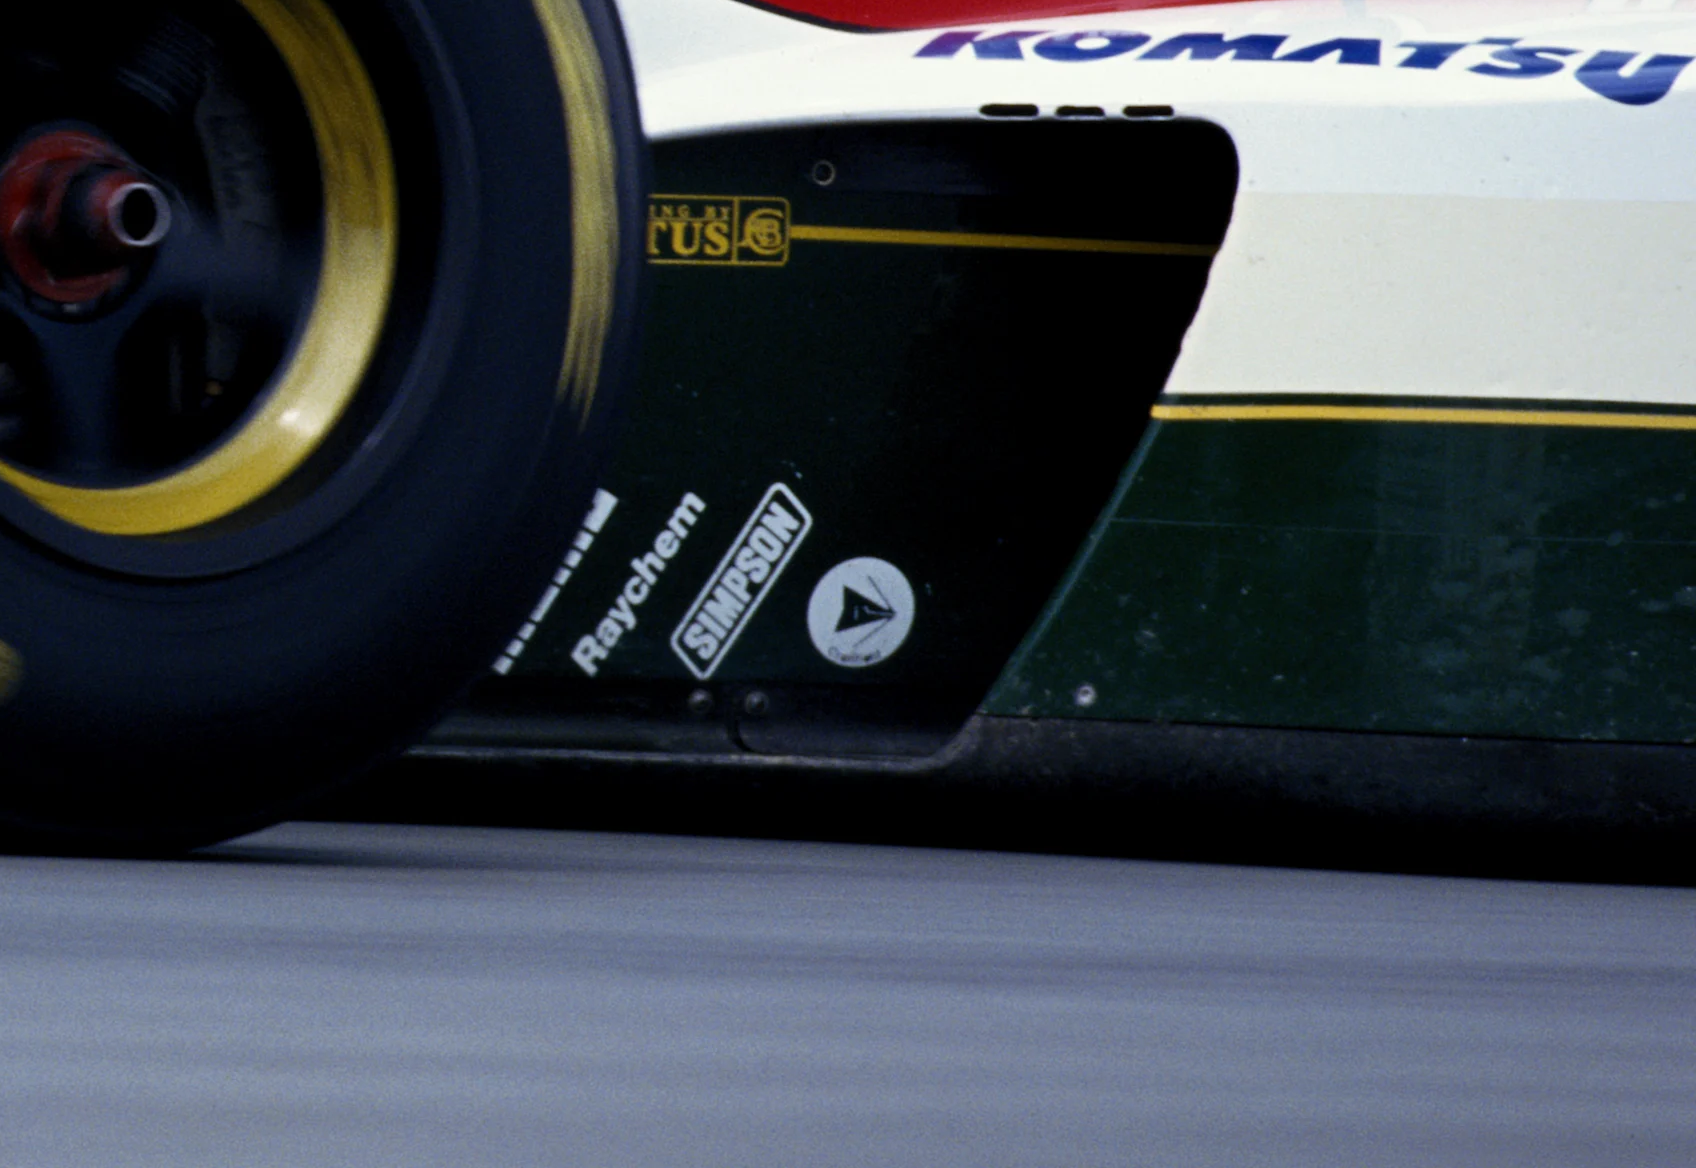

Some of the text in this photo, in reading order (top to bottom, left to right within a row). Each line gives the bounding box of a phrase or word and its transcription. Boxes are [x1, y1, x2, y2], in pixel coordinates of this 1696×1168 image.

[914, 30, 1696, 106] KOMATSU
[570, 491, 707, 677] Raychem
[681, 500, 802, 661] SIMPSON
